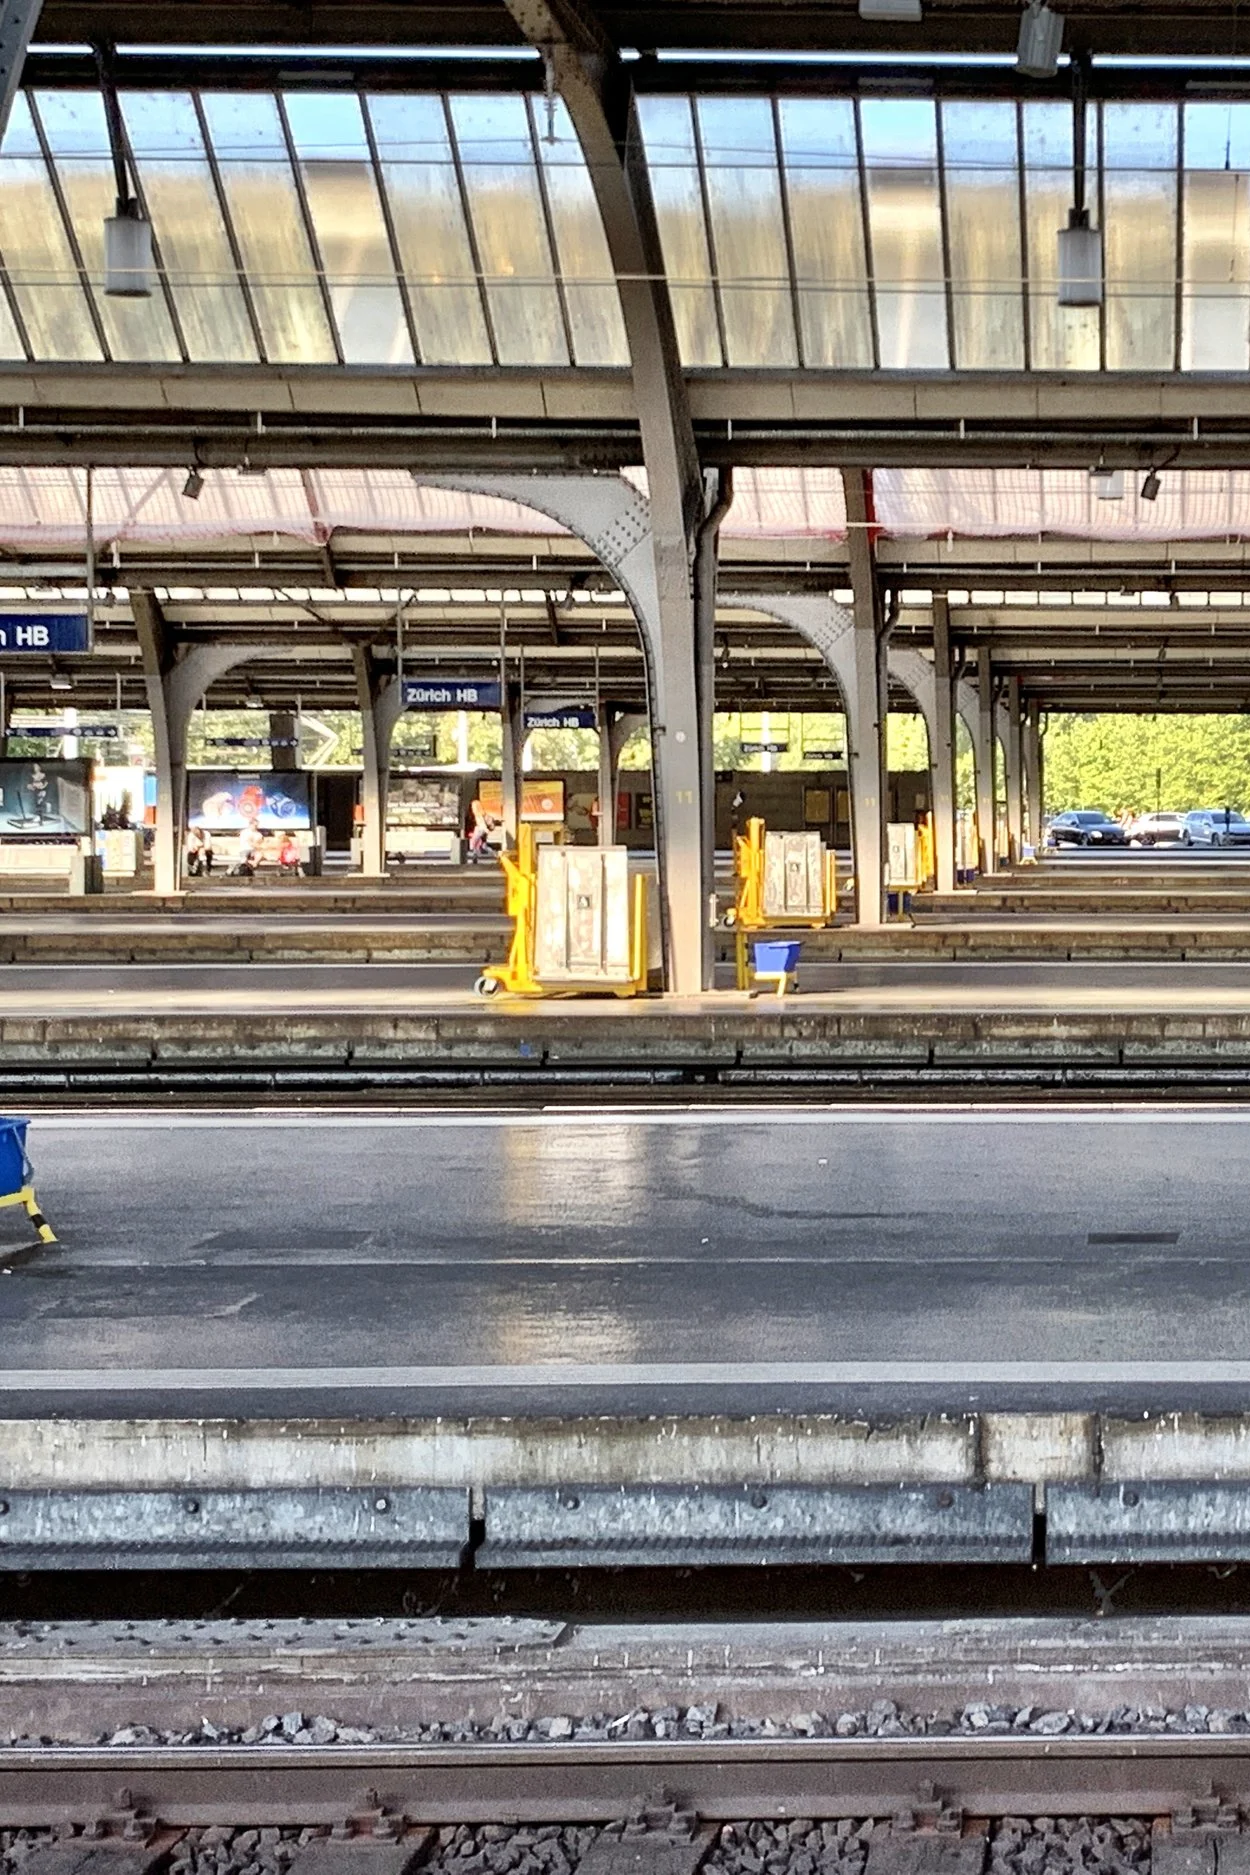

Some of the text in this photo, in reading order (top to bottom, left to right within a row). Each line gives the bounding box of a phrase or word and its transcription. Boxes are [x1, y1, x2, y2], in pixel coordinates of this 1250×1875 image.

[16, 625, 50, 646] HB
[406, 687, 479, 702] Zürich HB
[563, 717, 580, 728] HB
[676, 790, 693, 804] 11
